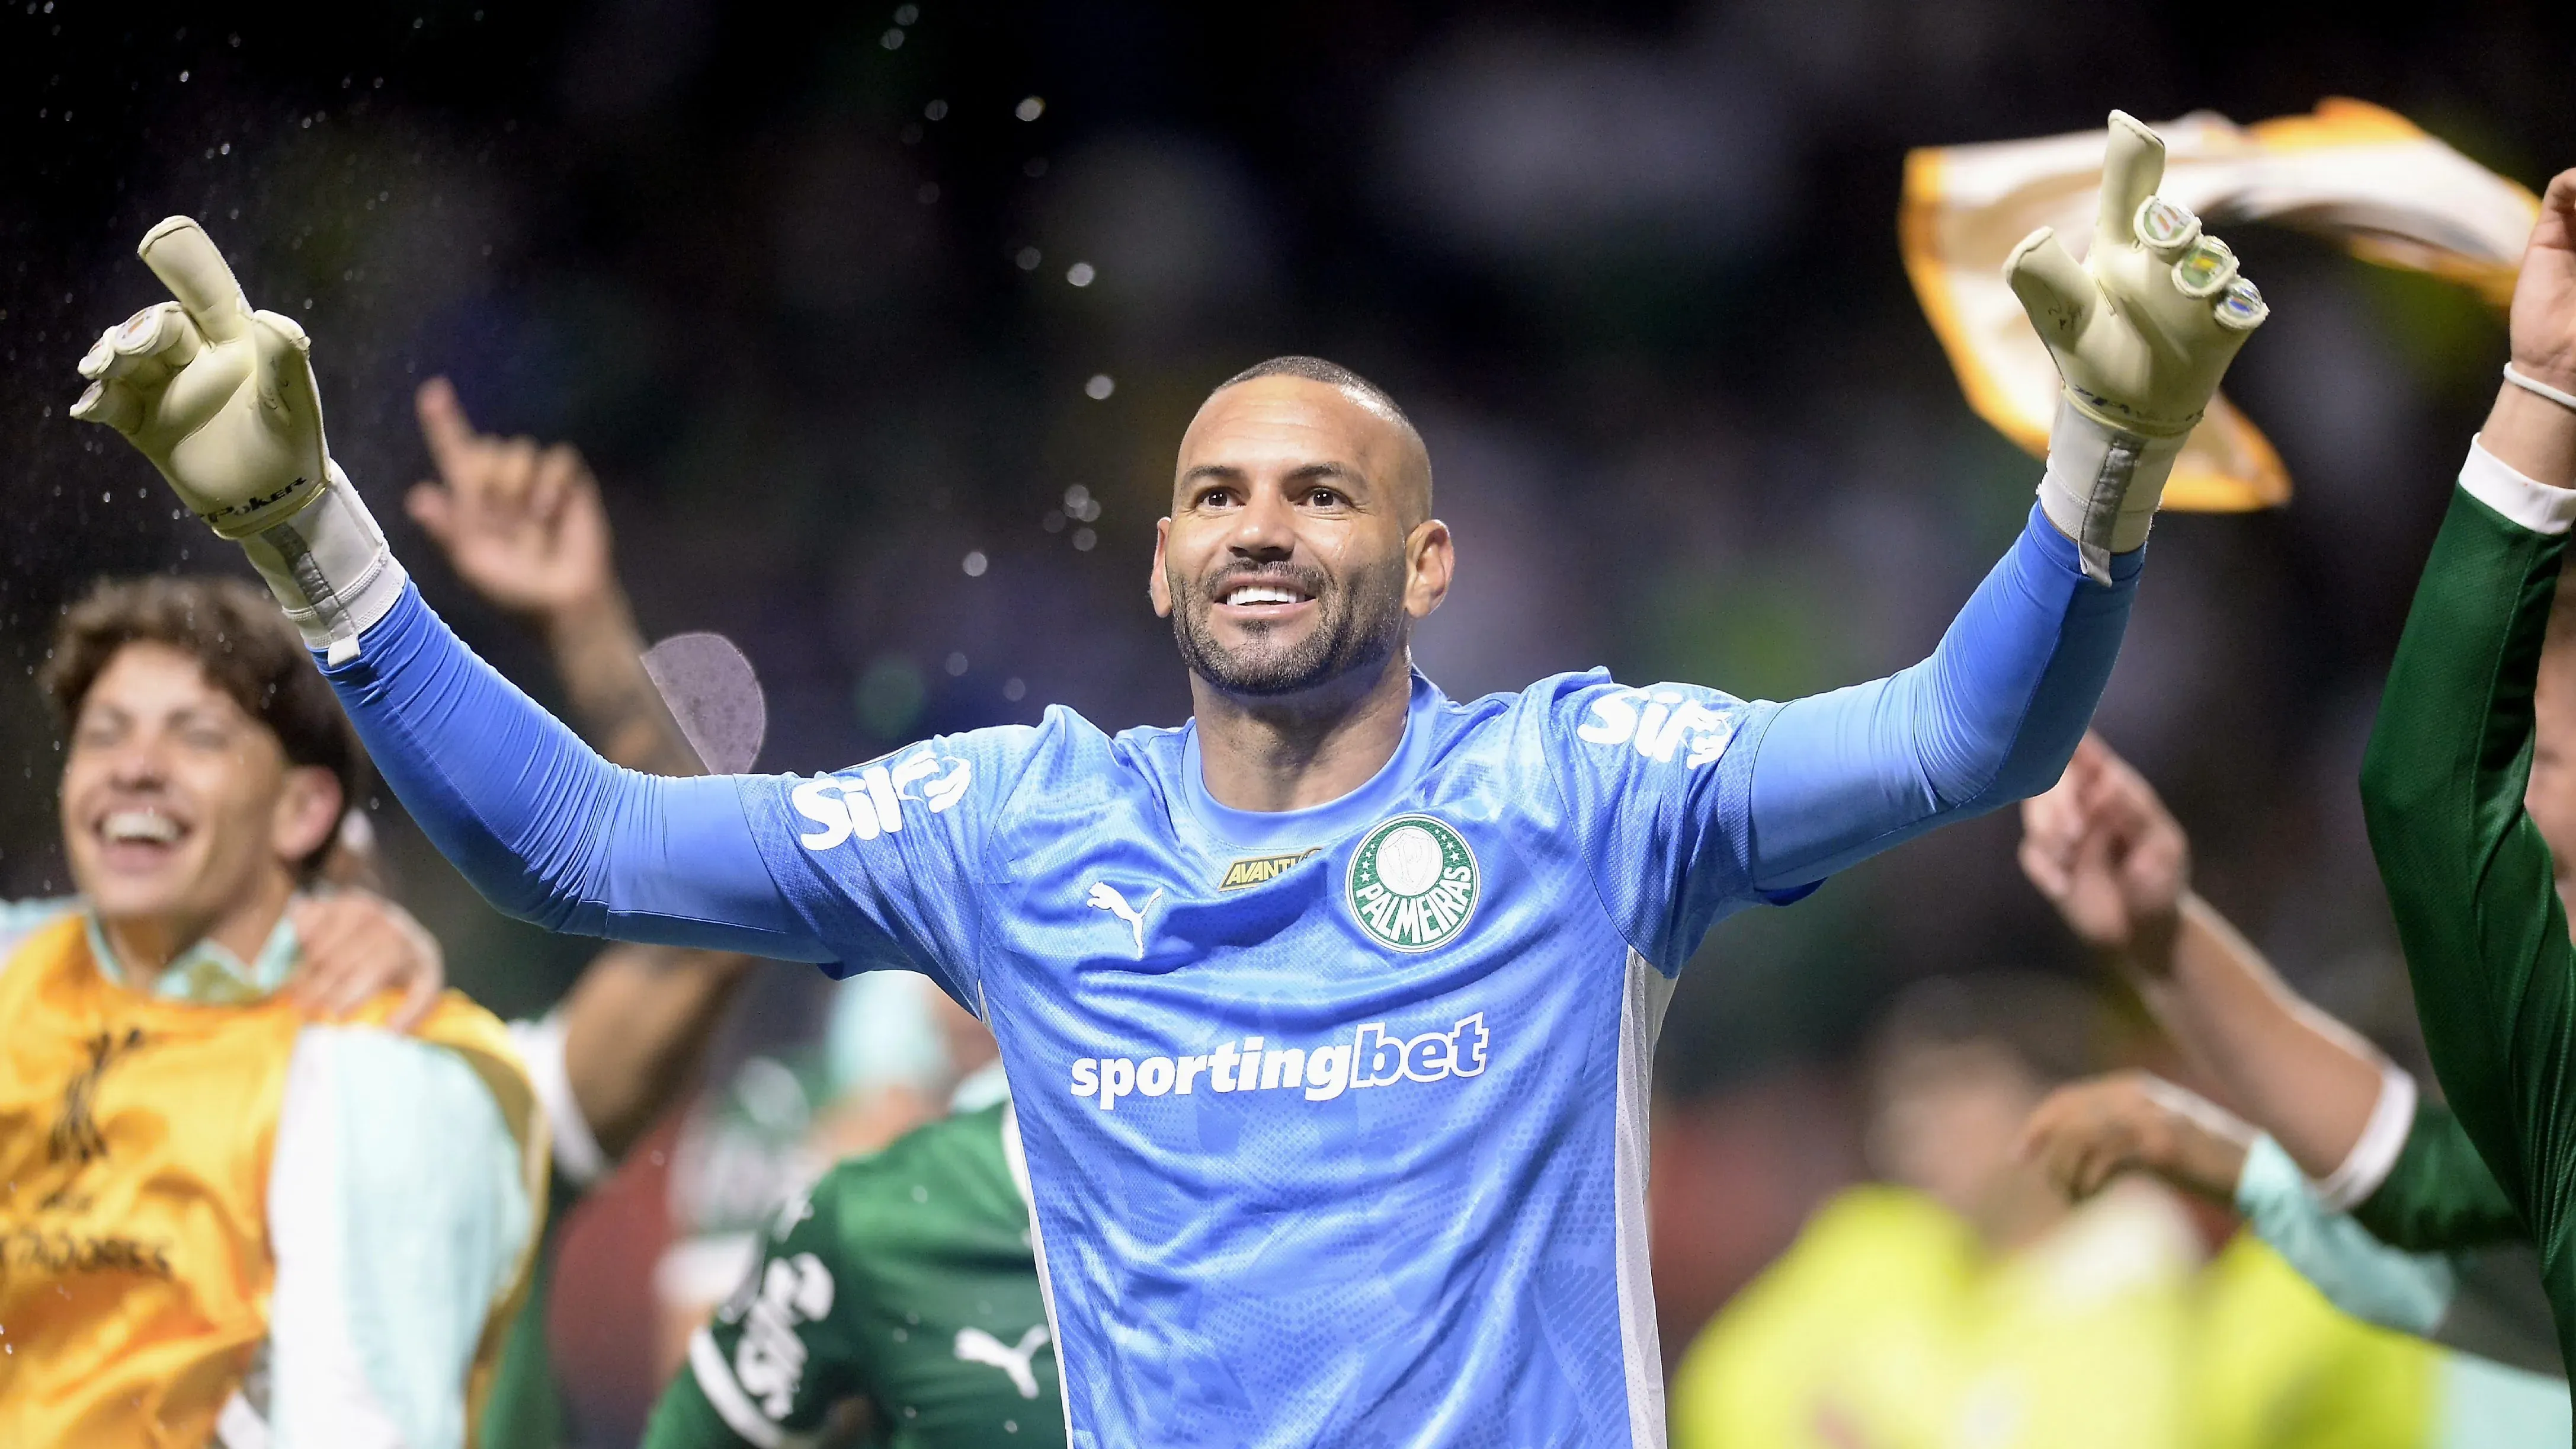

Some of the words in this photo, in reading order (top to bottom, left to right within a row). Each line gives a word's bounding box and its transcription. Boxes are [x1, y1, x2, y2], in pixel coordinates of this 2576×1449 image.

[792, 766, 903, 850] Sil
[1356, 866, 1472, 943] PALMEIRAS
[1071, 1012, 1489, 1111] sportingbet
